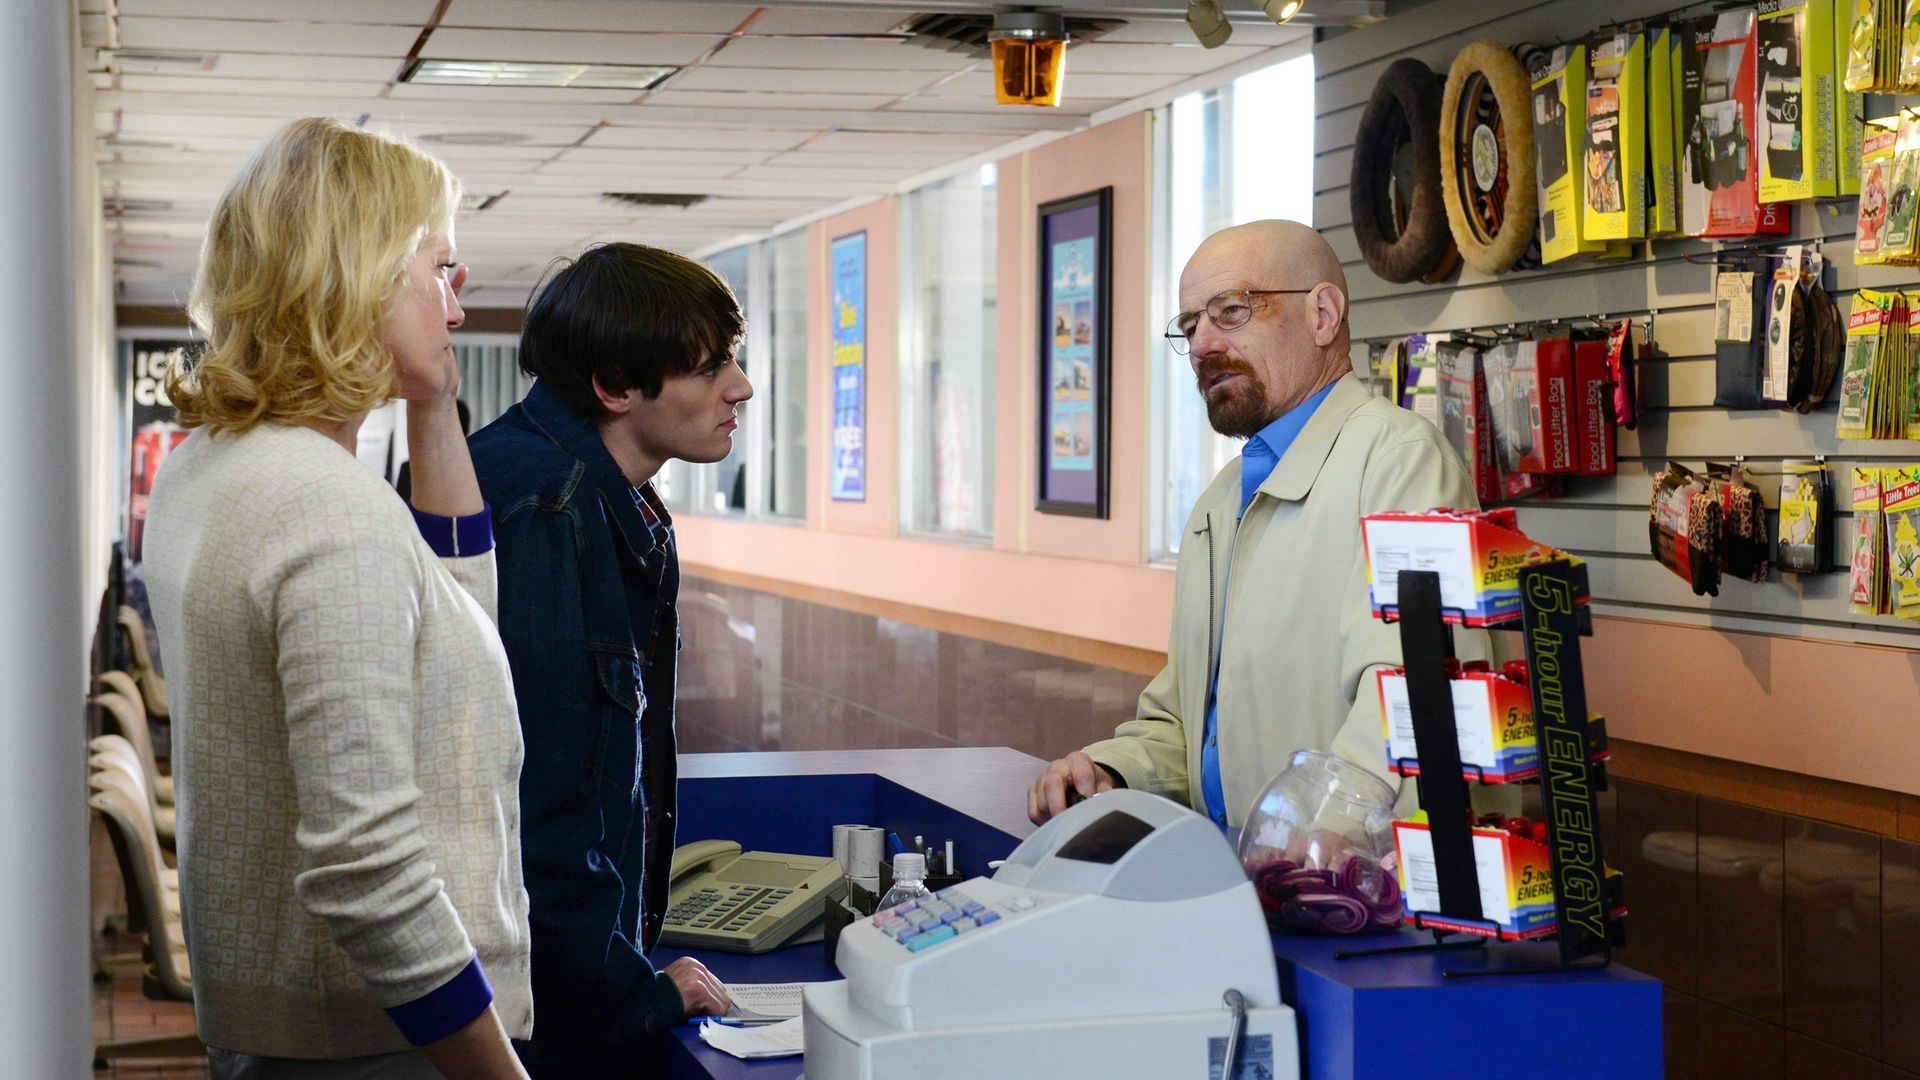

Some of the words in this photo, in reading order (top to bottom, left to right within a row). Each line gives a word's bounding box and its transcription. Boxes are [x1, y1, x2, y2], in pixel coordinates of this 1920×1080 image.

[1549, 377, 1562, 403] Bag
[1586, 379, 1601, 405] Bag
[1551, 406, 1562, 436] Litter
[1587, 408, 1599, 438] Litter
[1553, 439, 1564, 469] Floor
[1590, 442, 1601, 471] Floor
[1885, 488, 1902, 505] Little
[1488, 549, 1525, 570] 5-hour
[1484, 566, 1520, 585] ENERG
[1526, 573, 1572, 724] 5-hour
[1545, 725, 1605, 939] ENERGY
[1517, 880, 1552, 901] ENERG
